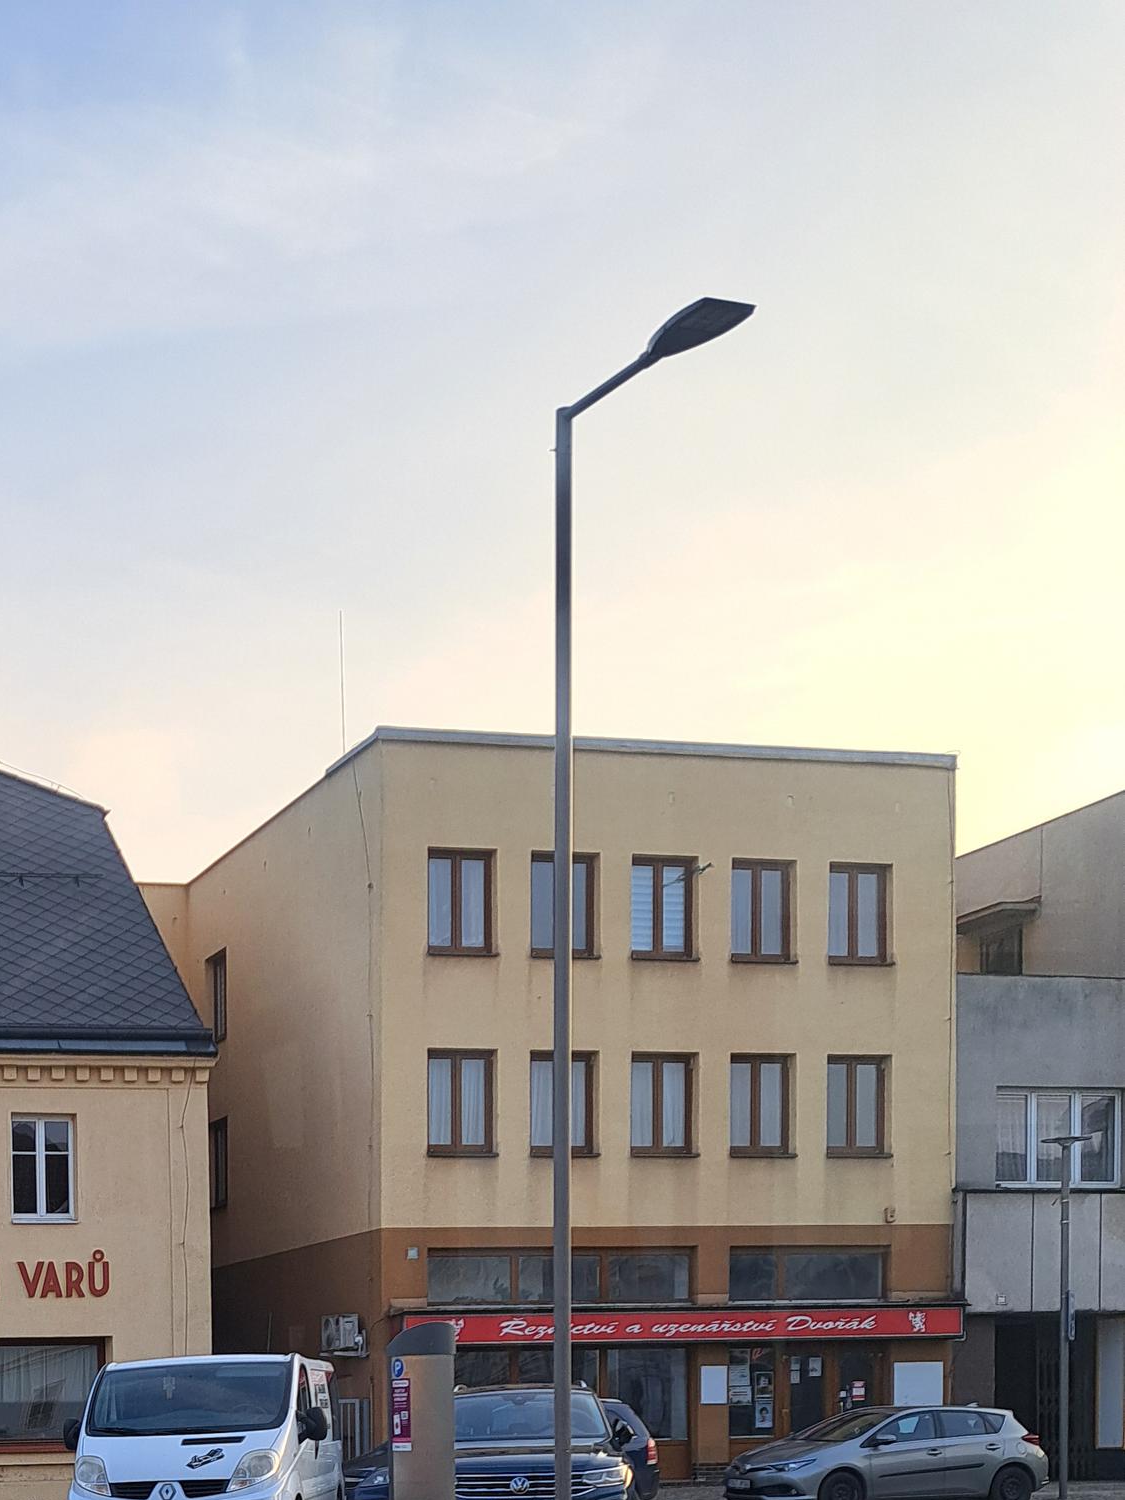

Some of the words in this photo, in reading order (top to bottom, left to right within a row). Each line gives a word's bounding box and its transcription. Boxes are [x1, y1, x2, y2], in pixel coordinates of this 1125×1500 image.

[17, 1249, 110, 1299] VARŮ
[499, 1317, 619, 1340] Řezctví
[625, 1322, 644, 1334] a
[651, 1319, 778, 1337] uzenářství
[785, 1314, 876, 1332] Dvořák
